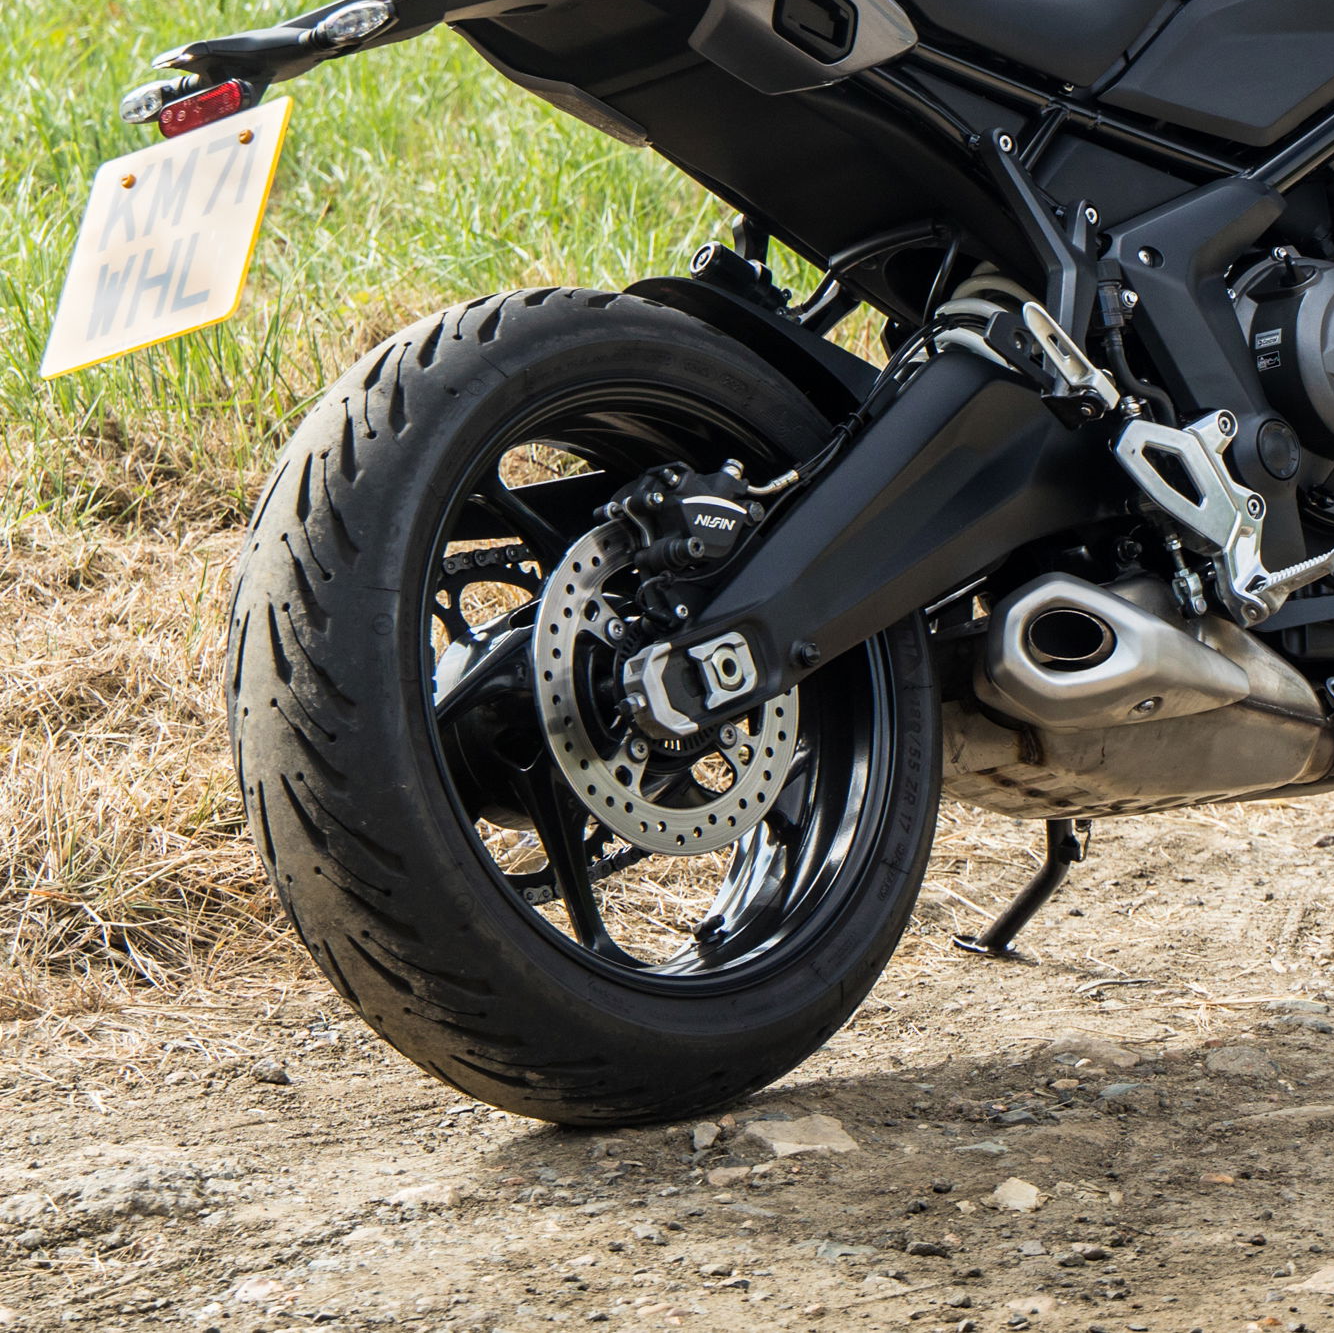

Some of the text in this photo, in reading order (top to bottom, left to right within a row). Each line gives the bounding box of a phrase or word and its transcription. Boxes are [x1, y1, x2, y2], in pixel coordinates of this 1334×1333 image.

[97, 125, 262, 252] KM71
[86, 232, 210, 341] WHL
[695, 514, 736, 531] NISSIN
